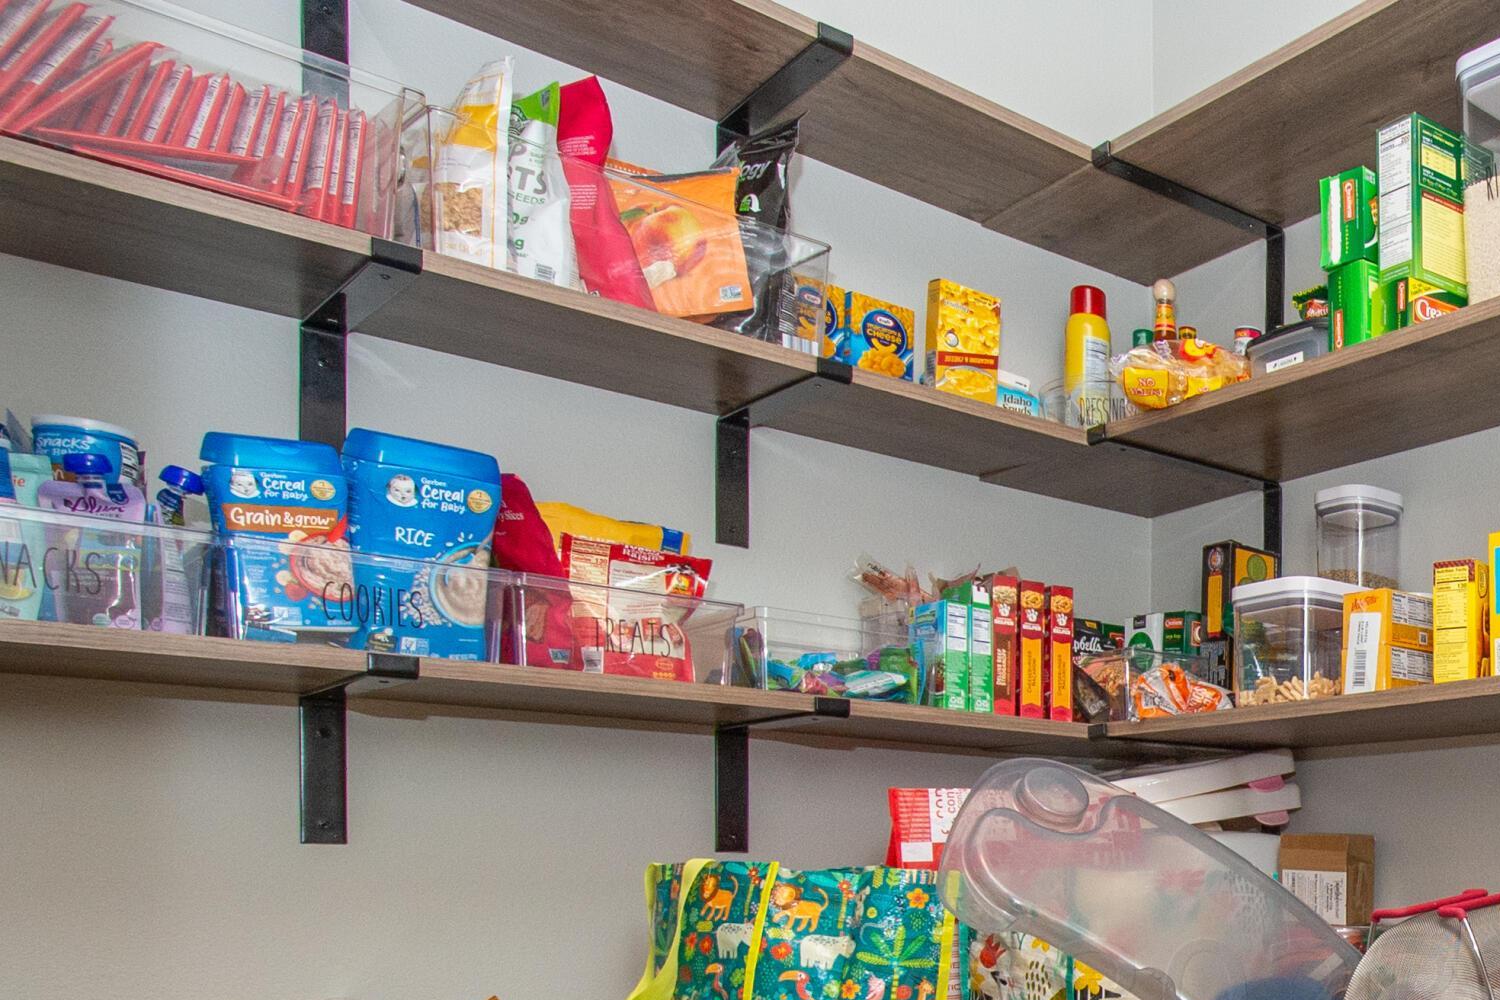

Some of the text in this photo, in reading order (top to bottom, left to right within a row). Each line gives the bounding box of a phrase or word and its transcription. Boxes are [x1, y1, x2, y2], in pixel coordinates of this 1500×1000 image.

[1139, 378, 1155, 386] NO
[1003, 393, 1032, 407] Idaho
[36, 436, 91, 450] Snacks
[262, 478, 305, 491] Cereal
[264, 490, 308, 501] for Baby
[420, 486, 464, 502] Cereal
[420, 500, 466, 514] for Baby
[230, 507, 281, 526] Grain
[394, 527, 435, 547] RICE
[322, 581, 424, 629] COOKIES
[593, 617, 671, 657] TREATS
